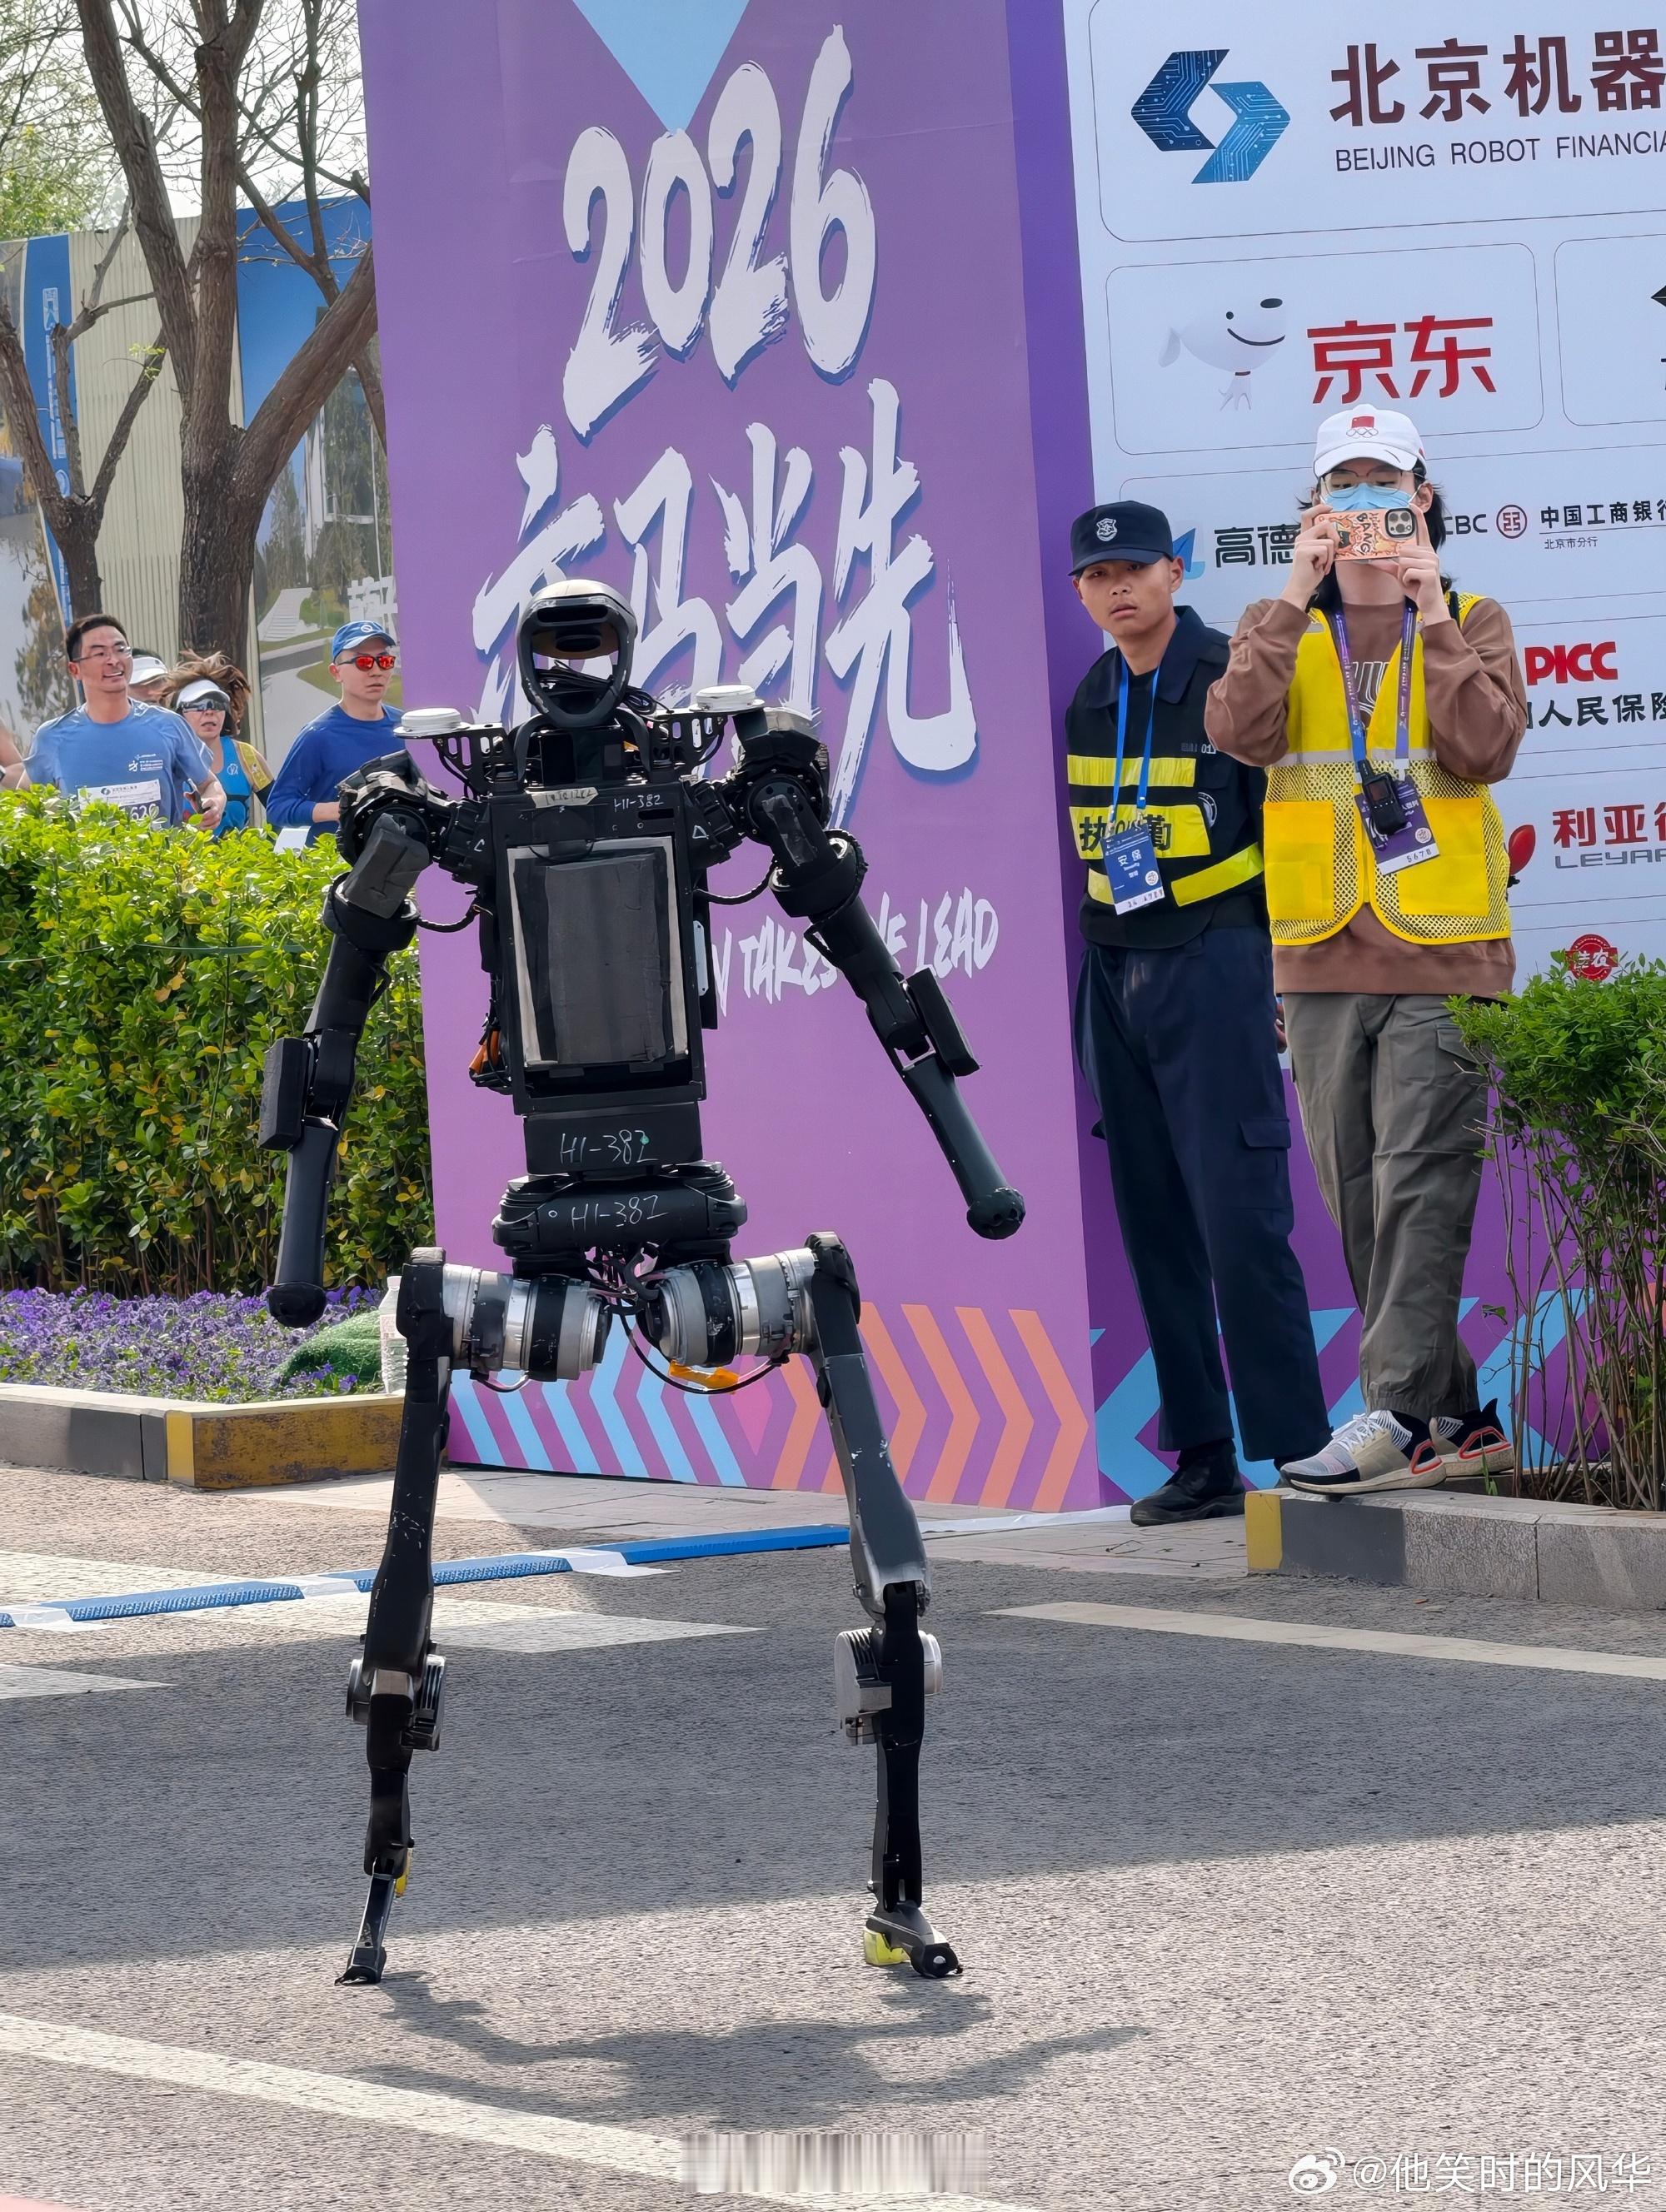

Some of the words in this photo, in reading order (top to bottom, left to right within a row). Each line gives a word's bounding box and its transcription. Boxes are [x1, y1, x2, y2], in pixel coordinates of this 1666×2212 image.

[1329, 28, 1666, 127] 北京机器
[1335, 143, 1435, 172] BEIJING
[1451, 138, 1541, 166] ROBOT
[563, 24, 877, 438] 2026
[1307, 315, 1497, 404] 京东
[1544, 536, 1599, 550] 北京市分行
[1524, 641, 1619, 686] PICC
[1552, 802, 1666, 848] 利亚
[913, 886, 1000, 979] LEAD
